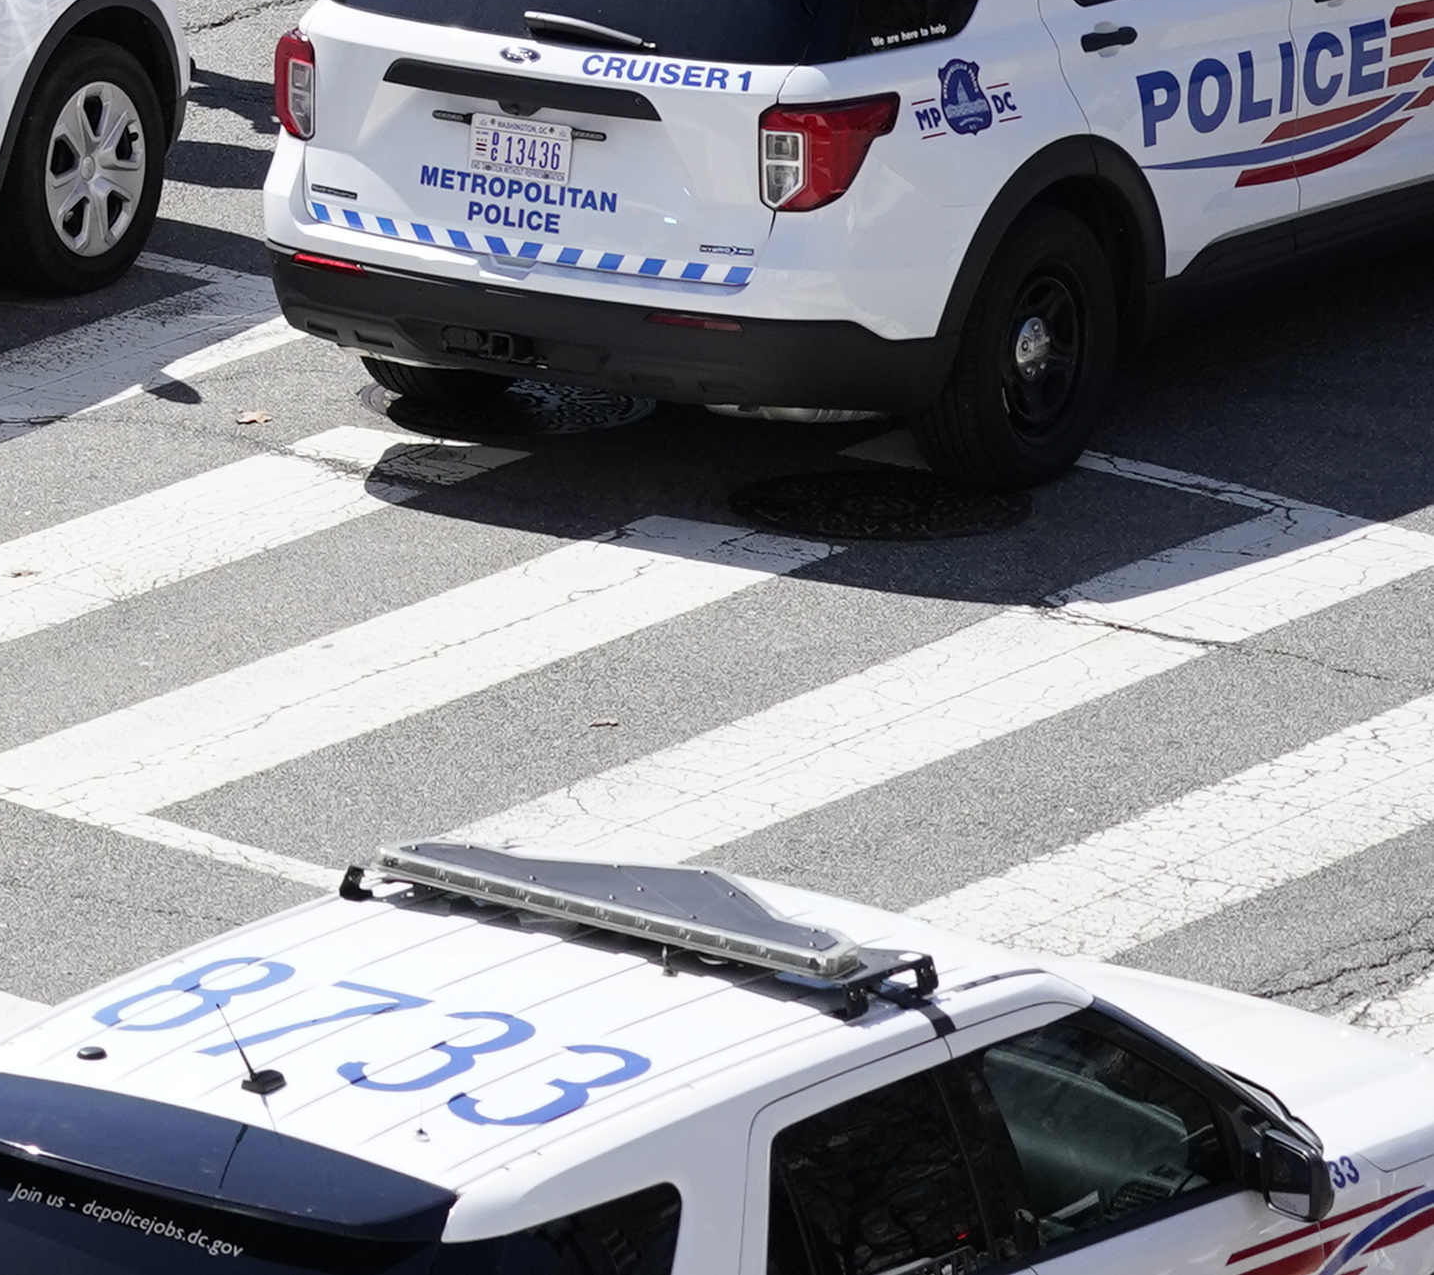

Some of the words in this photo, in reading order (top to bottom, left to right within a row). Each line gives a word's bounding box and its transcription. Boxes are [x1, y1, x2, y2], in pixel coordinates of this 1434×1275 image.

[871, 36, 885, 47] We
[886, 35, 900, 44] are
[901, 30, 918, 42] here
[920, 28, 928, 37] to
[930, 23, 946, 36] help
[582, 54, 729, 92] CRUISER
[738, 70, 752, 92] 1
[1136, 19, 1387, 148] POLICE
[914, 107, 942, 130] MP
[990, 92, 1017, 114] DC
[504, 136, 561, 170] 13436
[420, 164, 617, 213] METROPOLITAN
[468, 201, 560, 234] POLICE
[92, 956, 652, 1126] 8733
[7, 1183, 42, 1204] Join
[46, 1193, 64, 1208] us
[82, 1199, 244, 1258] dcpolicejobs.dc.gov
